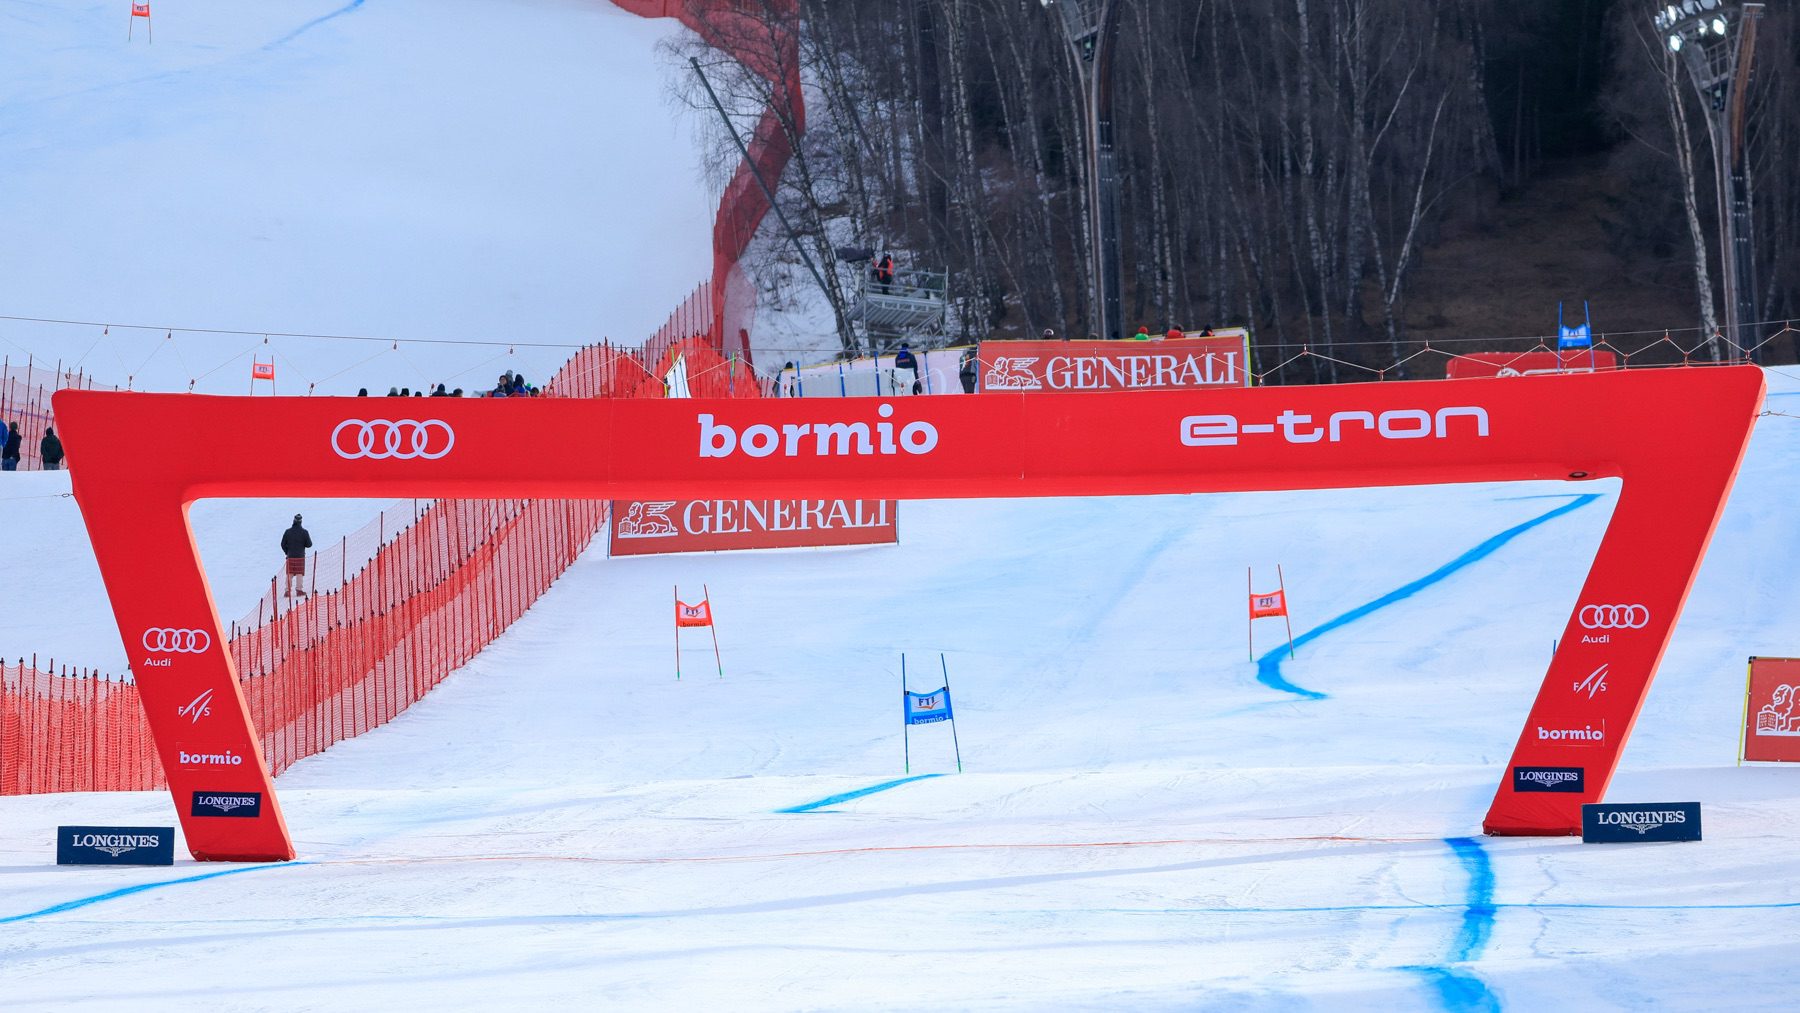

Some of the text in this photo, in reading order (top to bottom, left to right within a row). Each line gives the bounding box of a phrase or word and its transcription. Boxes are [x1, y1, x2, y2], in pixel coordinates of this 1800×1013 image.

[1046, 351, 1238, 389] GENERALI
[698, 403, 939, 458] bormio
[1180, 406, 1489, 447] e-tron
[683, 500, 890, 535] GENERALI
[1581, 634, 1610, 644] Audi
[143, 657, 171, 667] Audi
[913, 715, 944, 725] bormio
[1537, 725, 1603, 741] bormio
[179, 750, 242, 765] bormio
[1519, 771, 1578, 781] LONGINES
[198, 796, 256, 806] LONGINES
[1597, 810, 1686, 825] LONGINES
[72, 834, 160, 848] LONGINES
